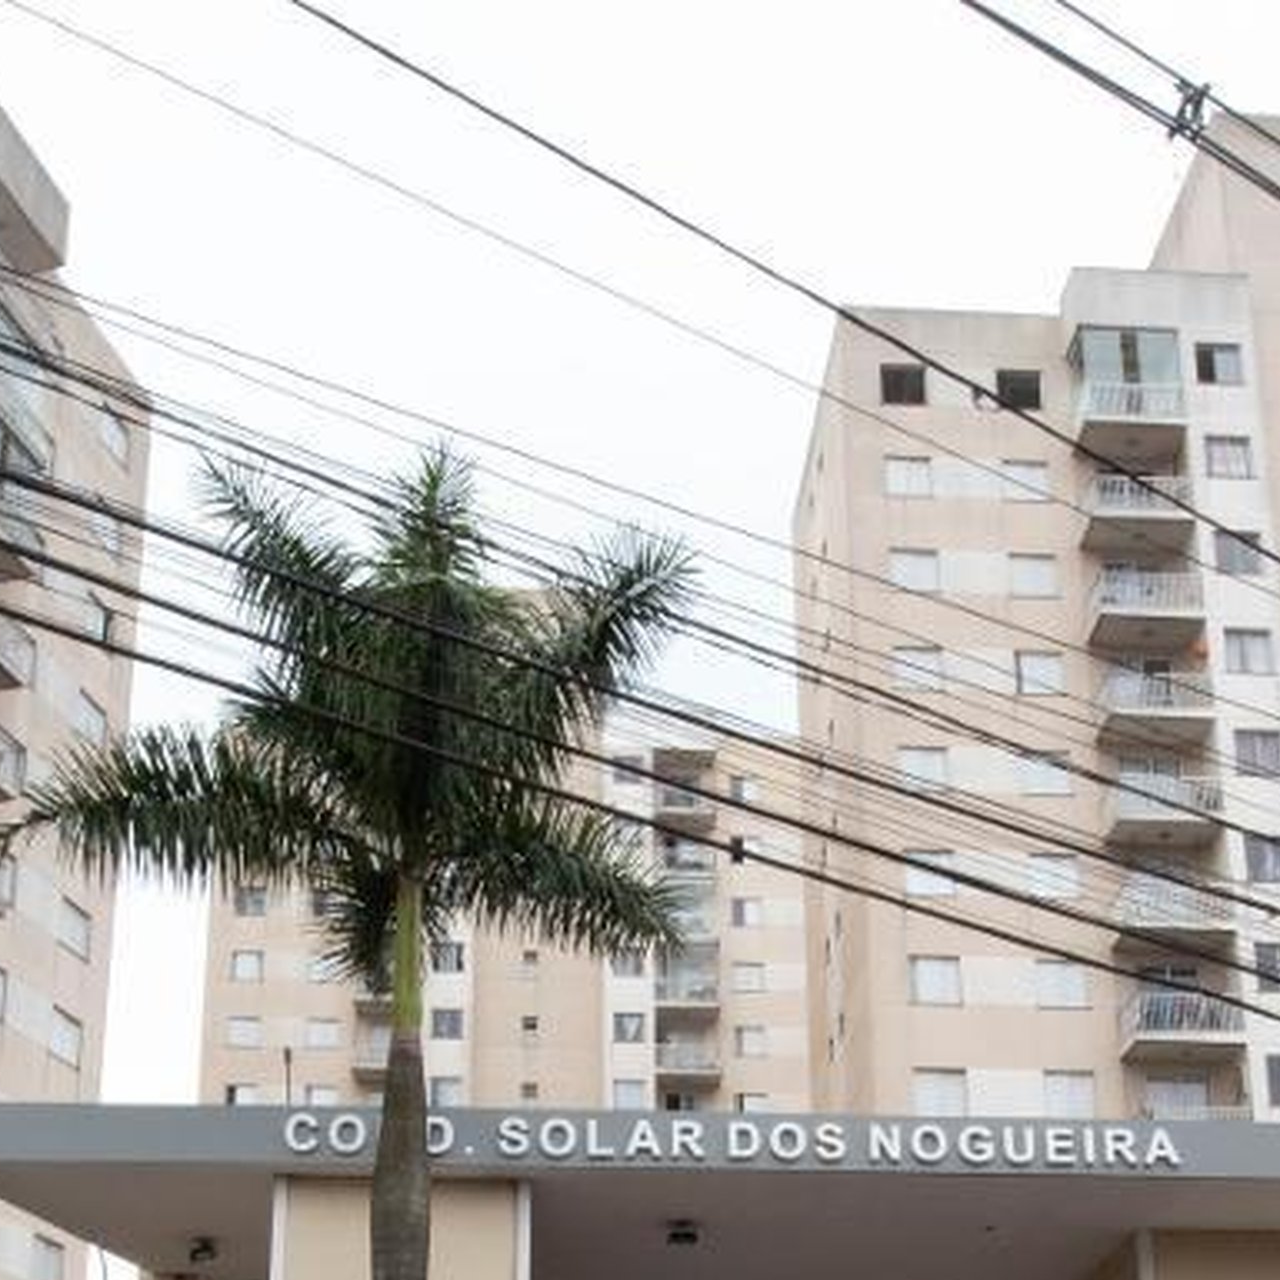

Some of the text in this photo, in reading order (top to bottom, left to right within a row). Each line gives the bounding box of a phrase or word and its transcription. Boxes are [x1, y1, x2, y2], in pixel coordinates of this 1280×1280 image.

[285, 1112, 1180, 1167] COD. SOLAR DOS NOGUEIRA
